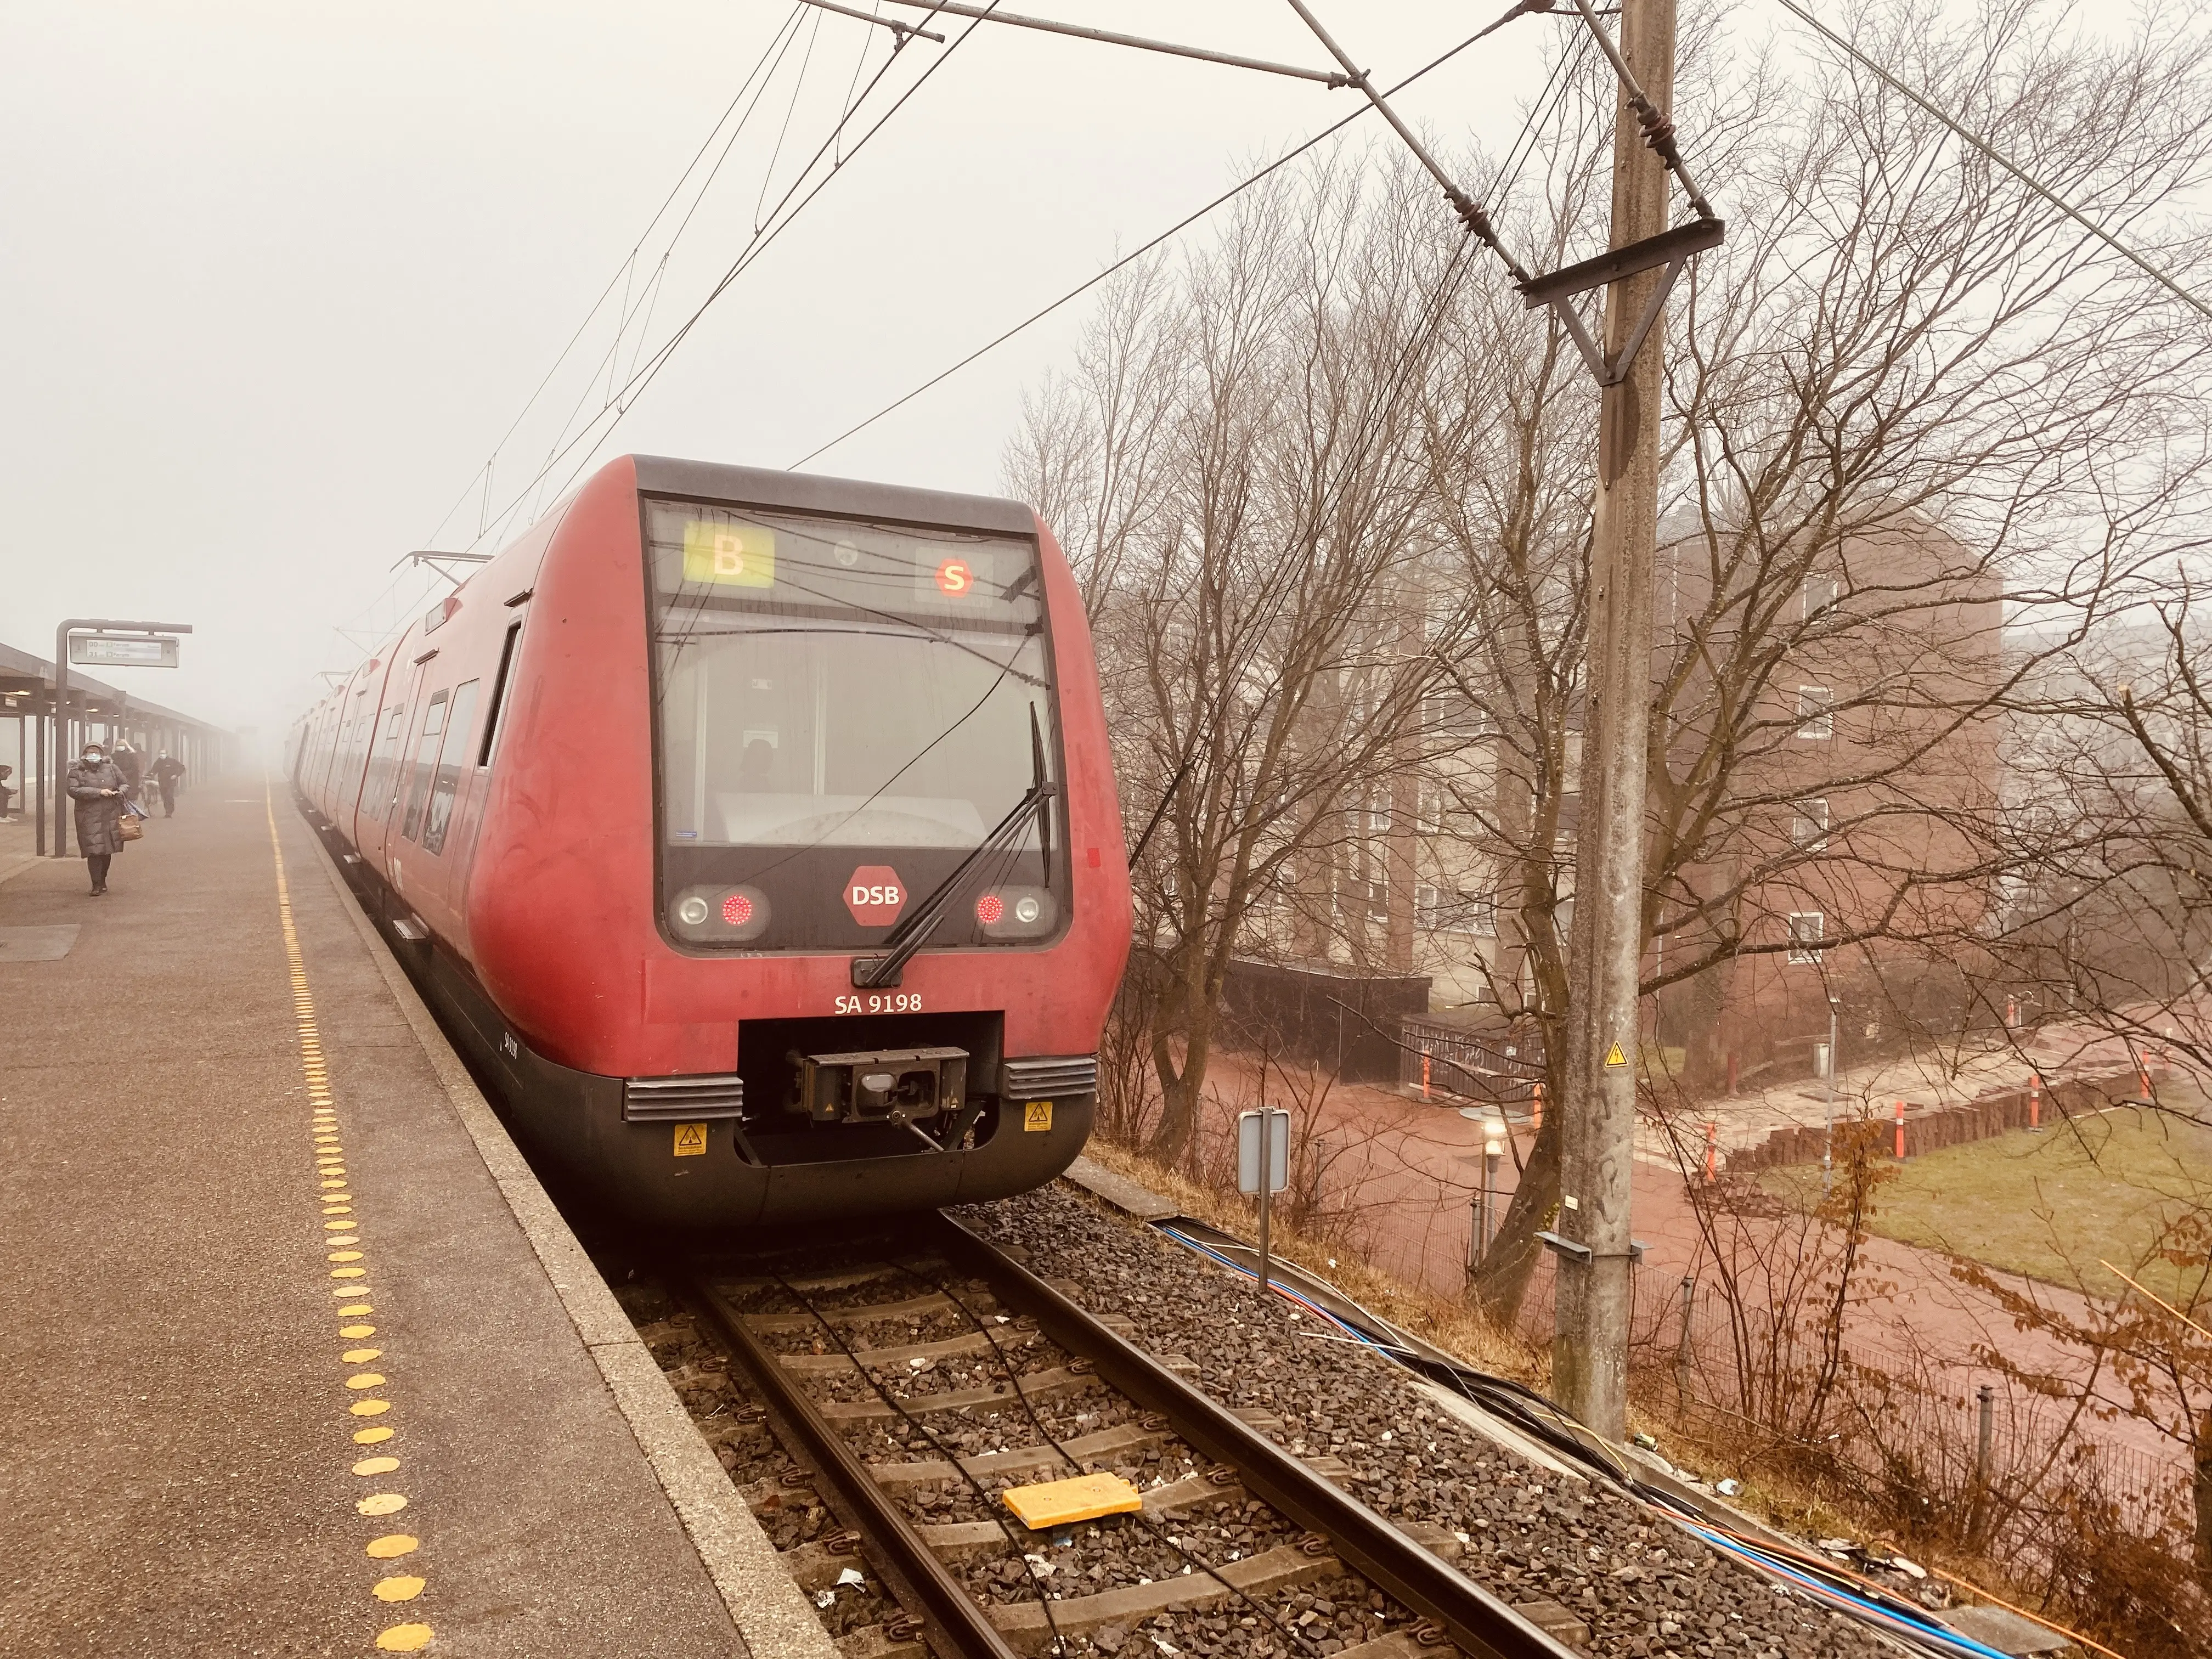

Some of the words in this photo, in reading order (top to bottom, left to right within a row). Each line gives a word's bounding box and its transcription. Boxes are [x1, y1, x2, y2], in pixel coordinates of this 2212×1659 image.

[714, 534, 744, 576] B
[943, 565, 965, 590] S
[852, 885, 900, 905] DSB
[834, 995, 862, 1014] SA
[868, 994, 922, 1013] 9198
